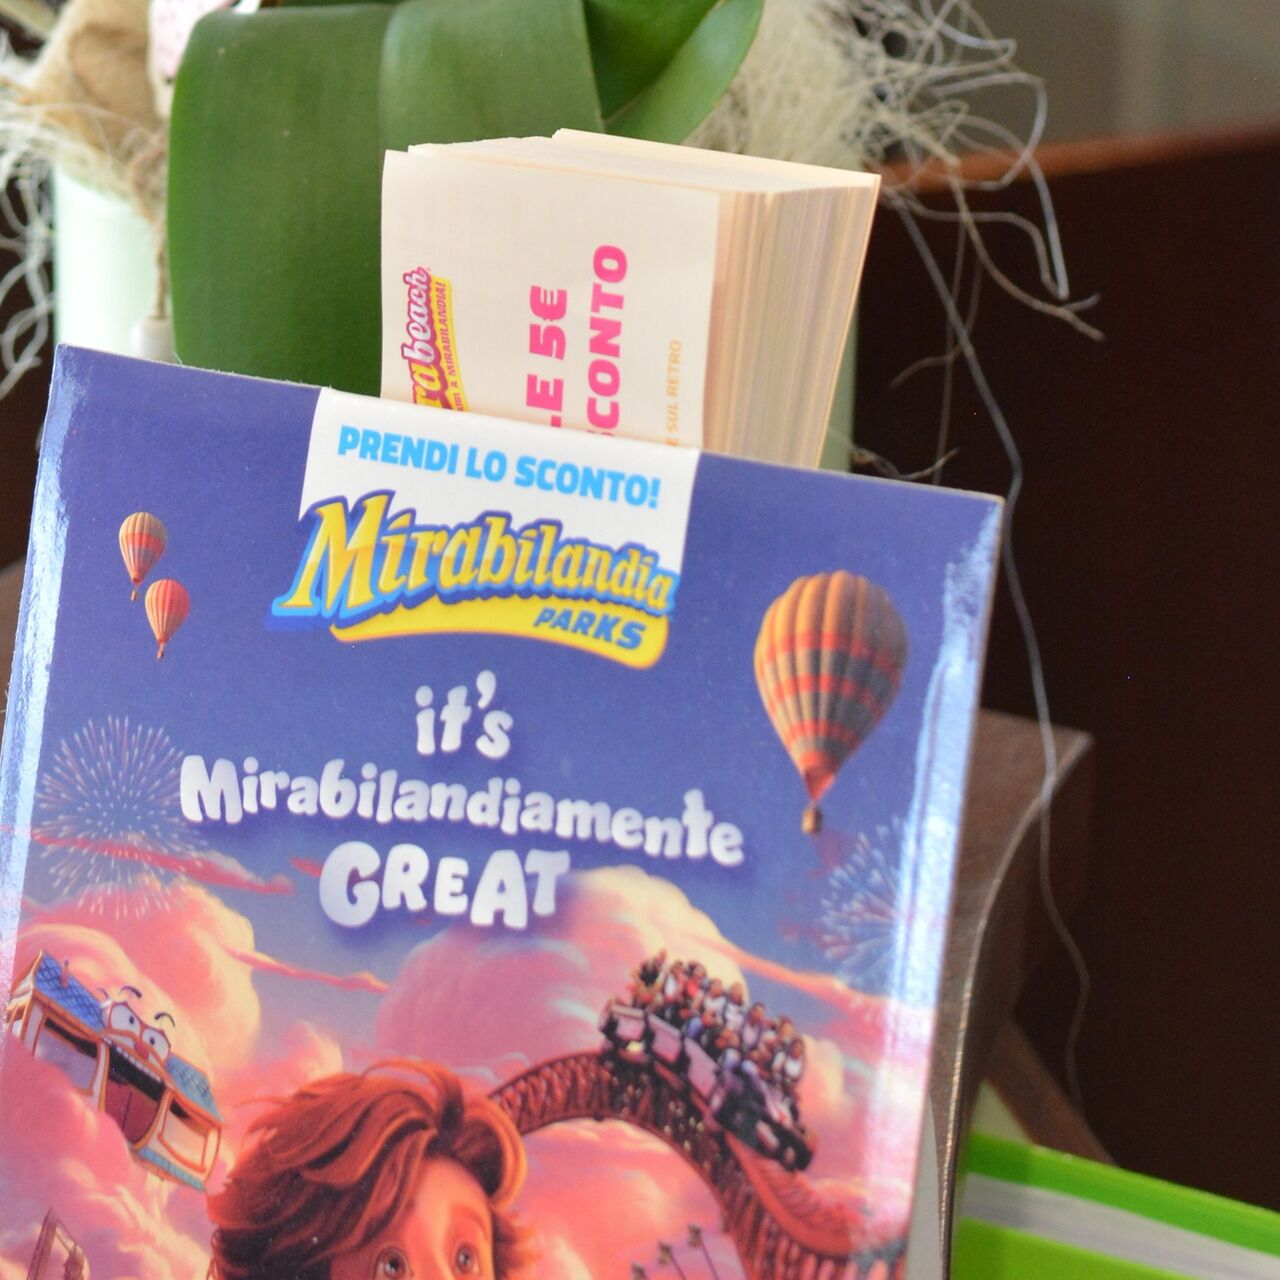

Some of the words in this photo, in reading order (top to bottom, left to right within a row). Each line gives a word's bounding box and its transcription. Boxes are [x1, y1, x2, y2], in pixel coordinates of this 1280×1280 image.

[435, 281, 457, 377] MIRABILANDIA!
[528, 285, 568, 361] 5€
[586, 244, 628, 437] CONTO
[666, 339, 682, 397] RETRO
[665, 402, 679, 432] SUL
[337, 424, 459, 474] PRENDI
[465, 449, 508, 482] LO
[515, 455, 661, 510] SCONTO!
[278, 491, 677, 614] Mirabilandia
[532, 606, 647, 651] PARKS
[414, 669, 514, 759] it's
[179, 754, 745, 866] Mirabilandiamente
[319, 840, 571, 929] GREAT
